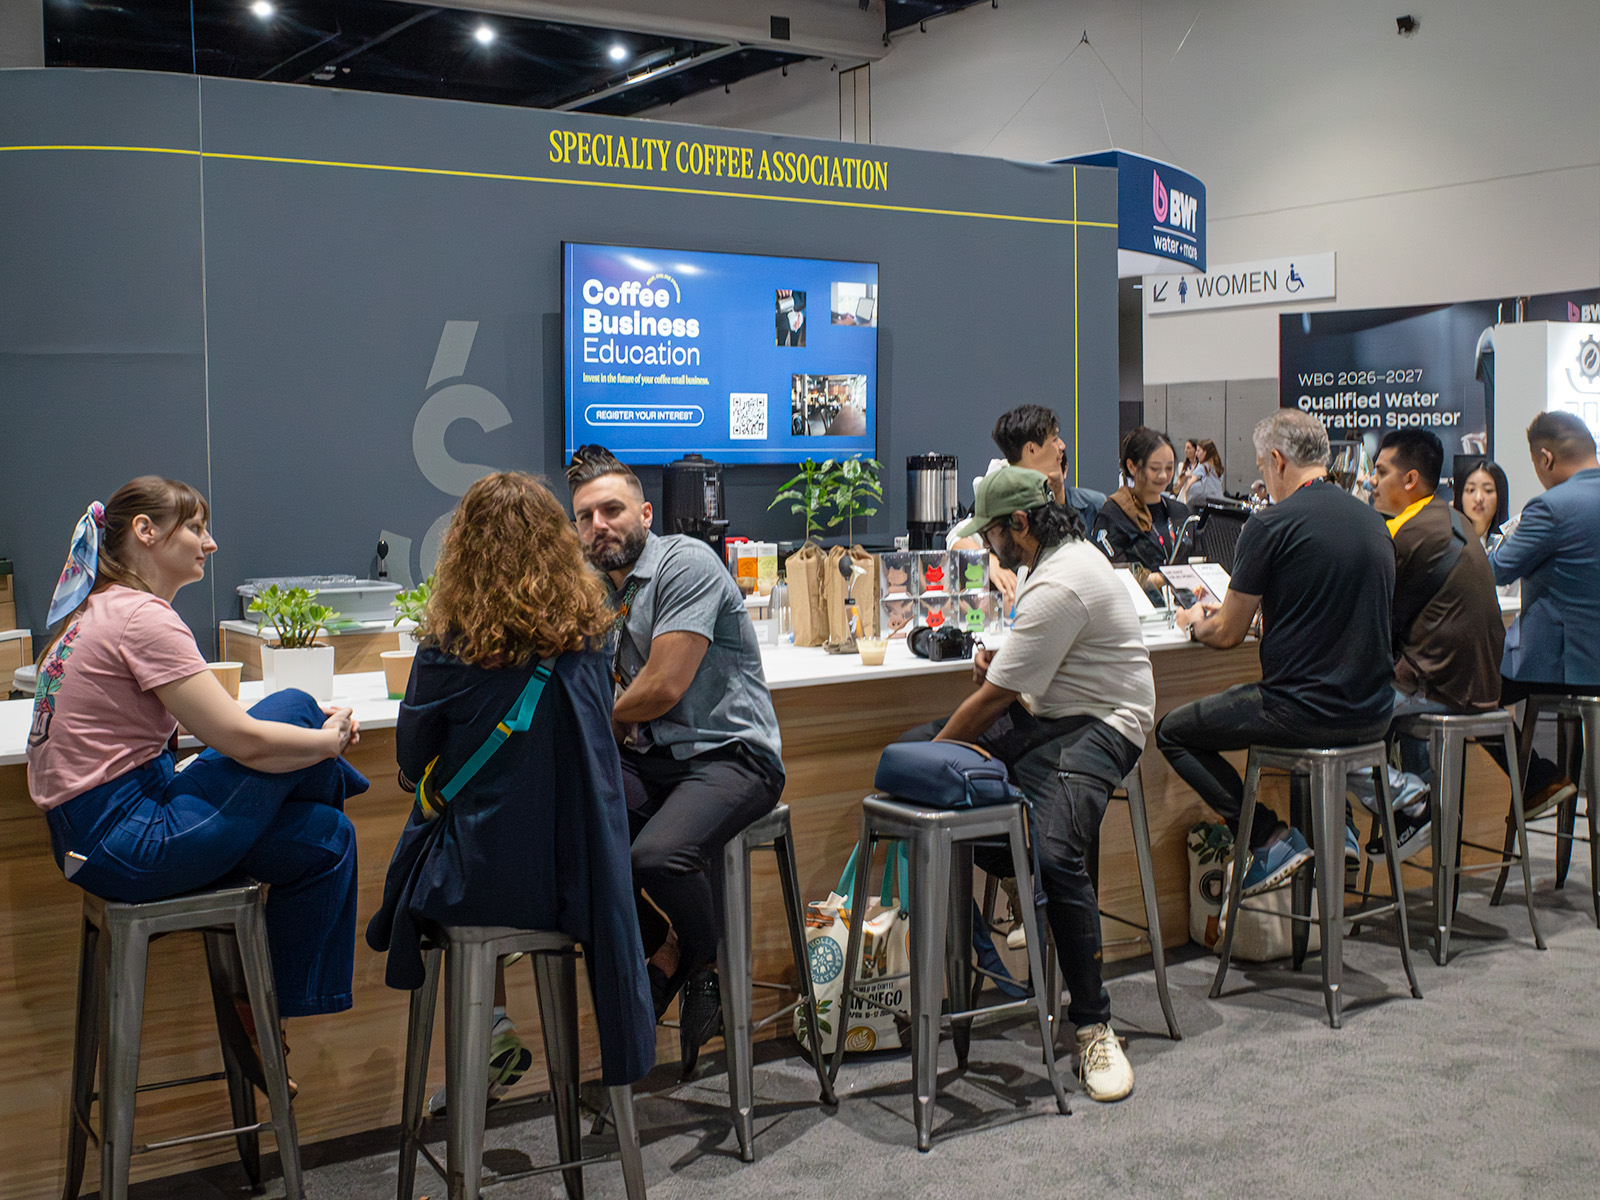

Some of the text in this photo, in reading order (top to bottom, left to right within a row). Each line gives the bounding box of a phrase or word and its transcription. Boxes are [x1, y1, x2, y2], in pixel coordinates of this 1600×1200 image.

[549, 129, 889, 191] SPECIALTY COFFEE ASSOCIATION
[1169, 188, 1198, 233] BWT
[582, 278, 670, 308] Coffee
[1196, 269, 1277, 298] WOMEN
[583, 308, 700, 338] Business
[1581, 303, 1600, 322] BW
[583, 337, 700, 366] Education
[582, 372, 600, 383] Invest
[600, 372, 607, 383] in
[607, 372, 617, 384] the
[616, 372, 634, 384] future
[634, 372, 641, 384] of
[641, 375, 654, 387] your
[654, 373, 671, 385] coffee
[671, 374, 685, 385] retail
[1298, 372, 1334, 387] WBC
[1297, 391, 1440, 412] Qualified Water
[595, 410, 694, 421] REGISTER YOUR INTEREST
[1309, 411, 1461, 431] tration Sponsor
[867, 989, 903, 1010] DIEGO
